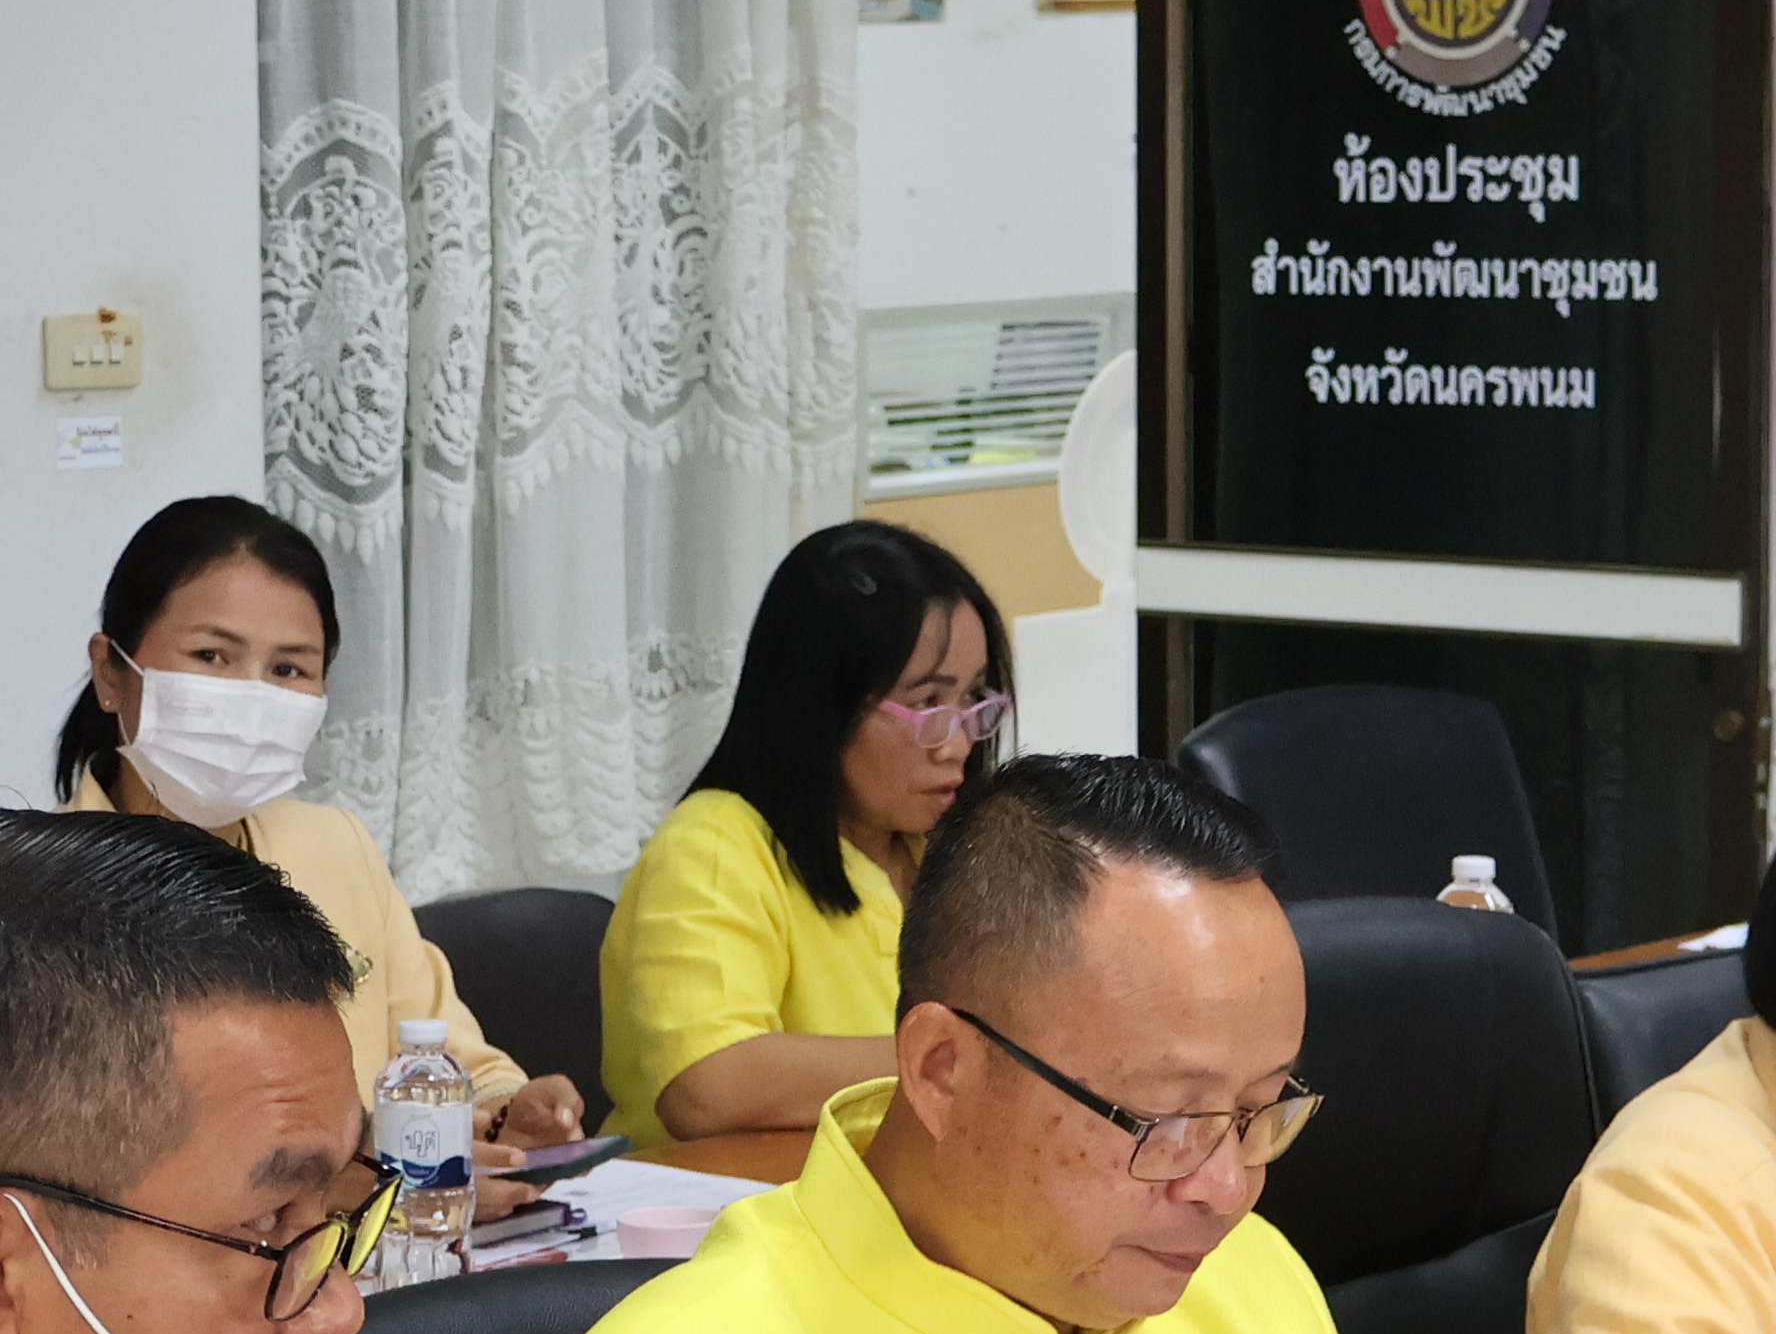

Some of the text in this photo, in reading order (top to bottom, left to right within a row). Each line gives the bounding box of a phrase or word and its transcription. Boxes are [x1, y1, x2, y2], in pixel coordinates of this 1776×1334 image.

[1333, 134, 1579, 222] ห้องประชุม
[1251, 239, 1658, 317] สำนักงานพัฒนาชุมชน
[1305, 347, 1595, 409] จังหวัดนครพนม
